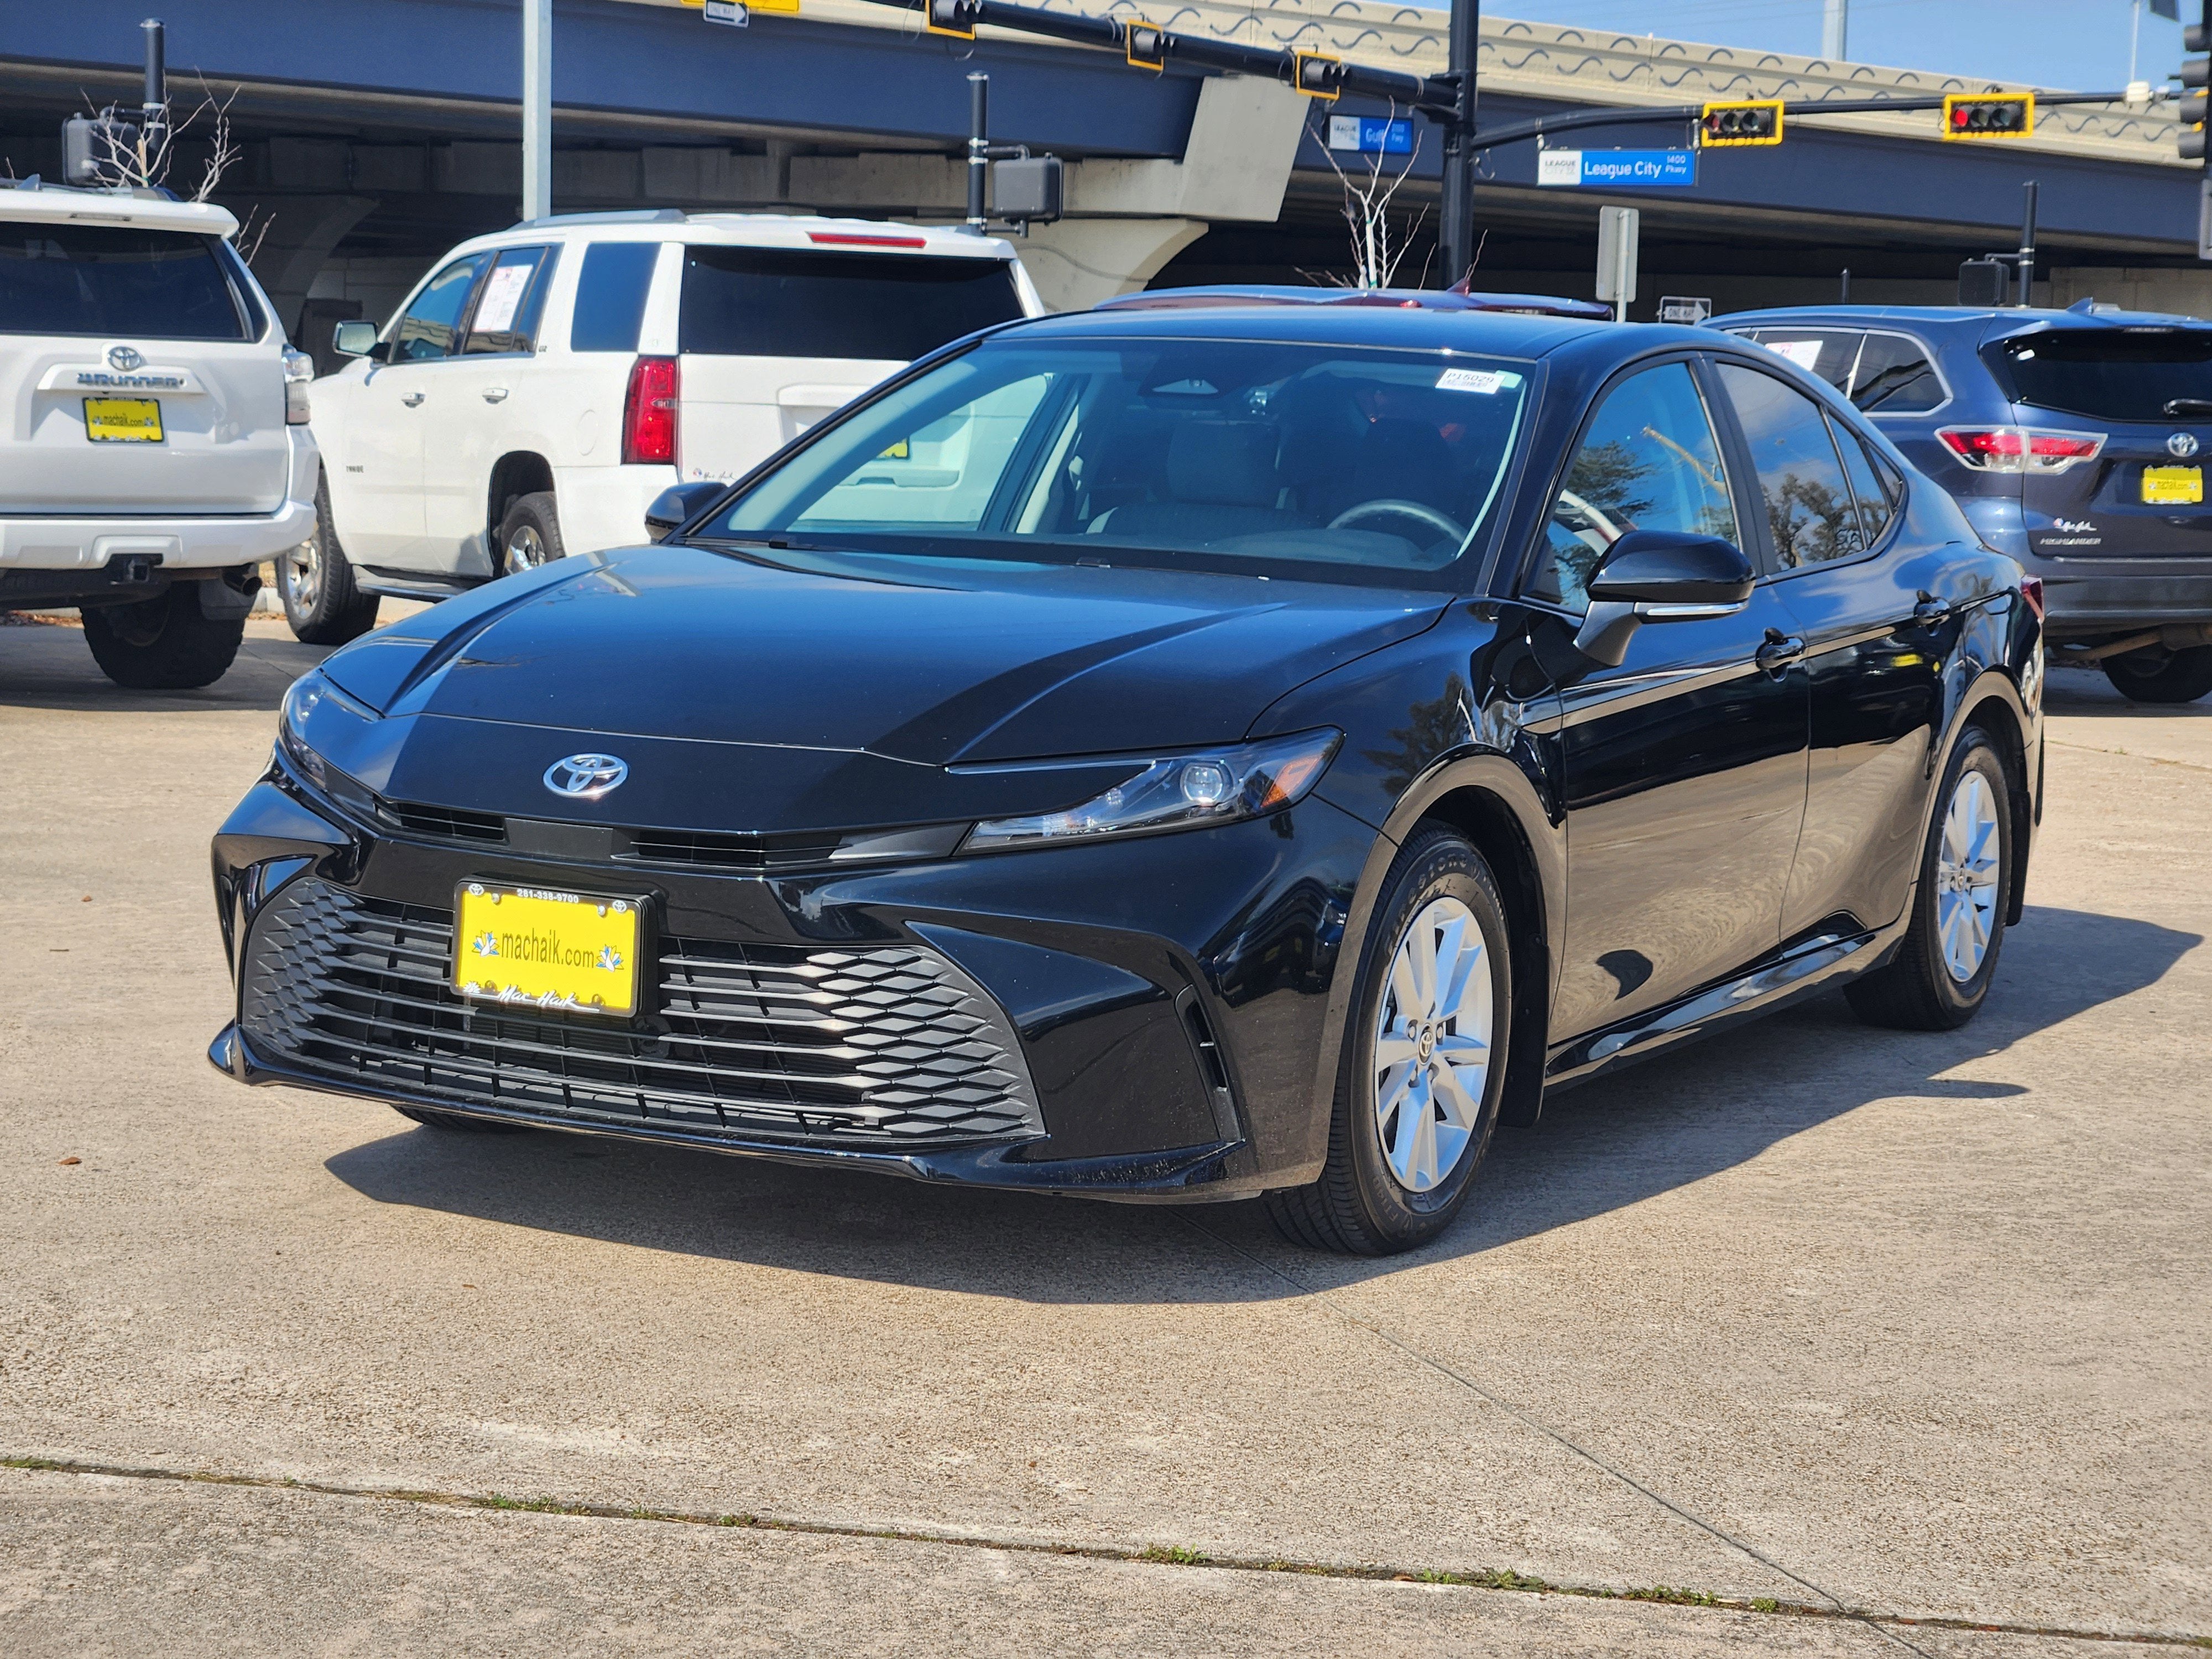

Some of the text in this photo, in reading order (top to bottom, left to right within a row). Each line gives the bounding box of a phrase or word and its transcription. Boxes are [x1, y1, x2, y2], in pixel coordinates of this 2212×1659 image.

[1584, 161, 1662, 179] League City
[517, 888, 579, 904] 281-338-9700
[502, 927, 594, 968] machaik.com
[497, 984, 536, 1003] Mac
